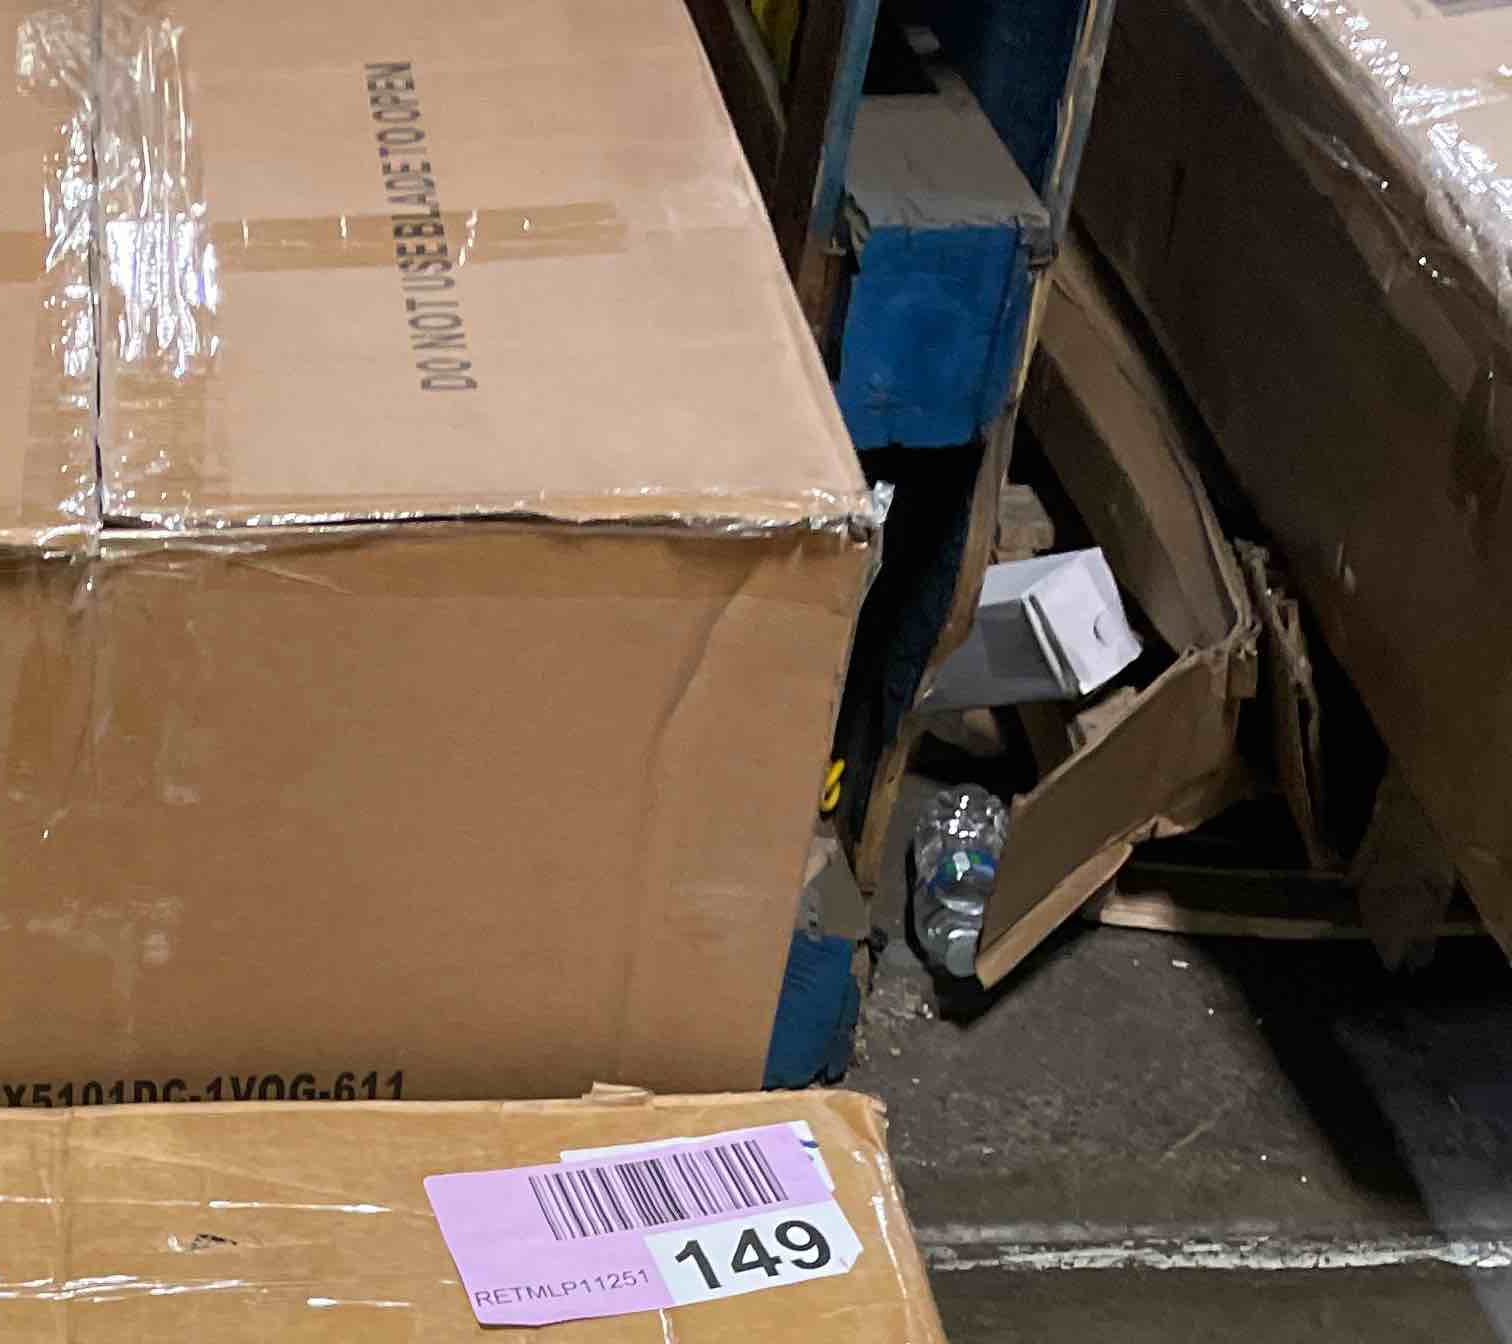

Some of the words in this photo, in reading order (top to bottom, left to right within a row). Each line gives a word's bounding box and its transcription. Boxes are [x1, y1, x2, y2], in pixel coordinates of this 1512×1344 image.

[365, 61, 421, 122] OPEN
[382, 161, 444, 238] BLADE
[396, 242, 455, 292] USE
[406, 298, 468, 350] NOT
[416, 357, 478, 391] DO
[675, 1219, 831, 1290] 149
[474, 1269, 649, 1307] RETMLP11251
